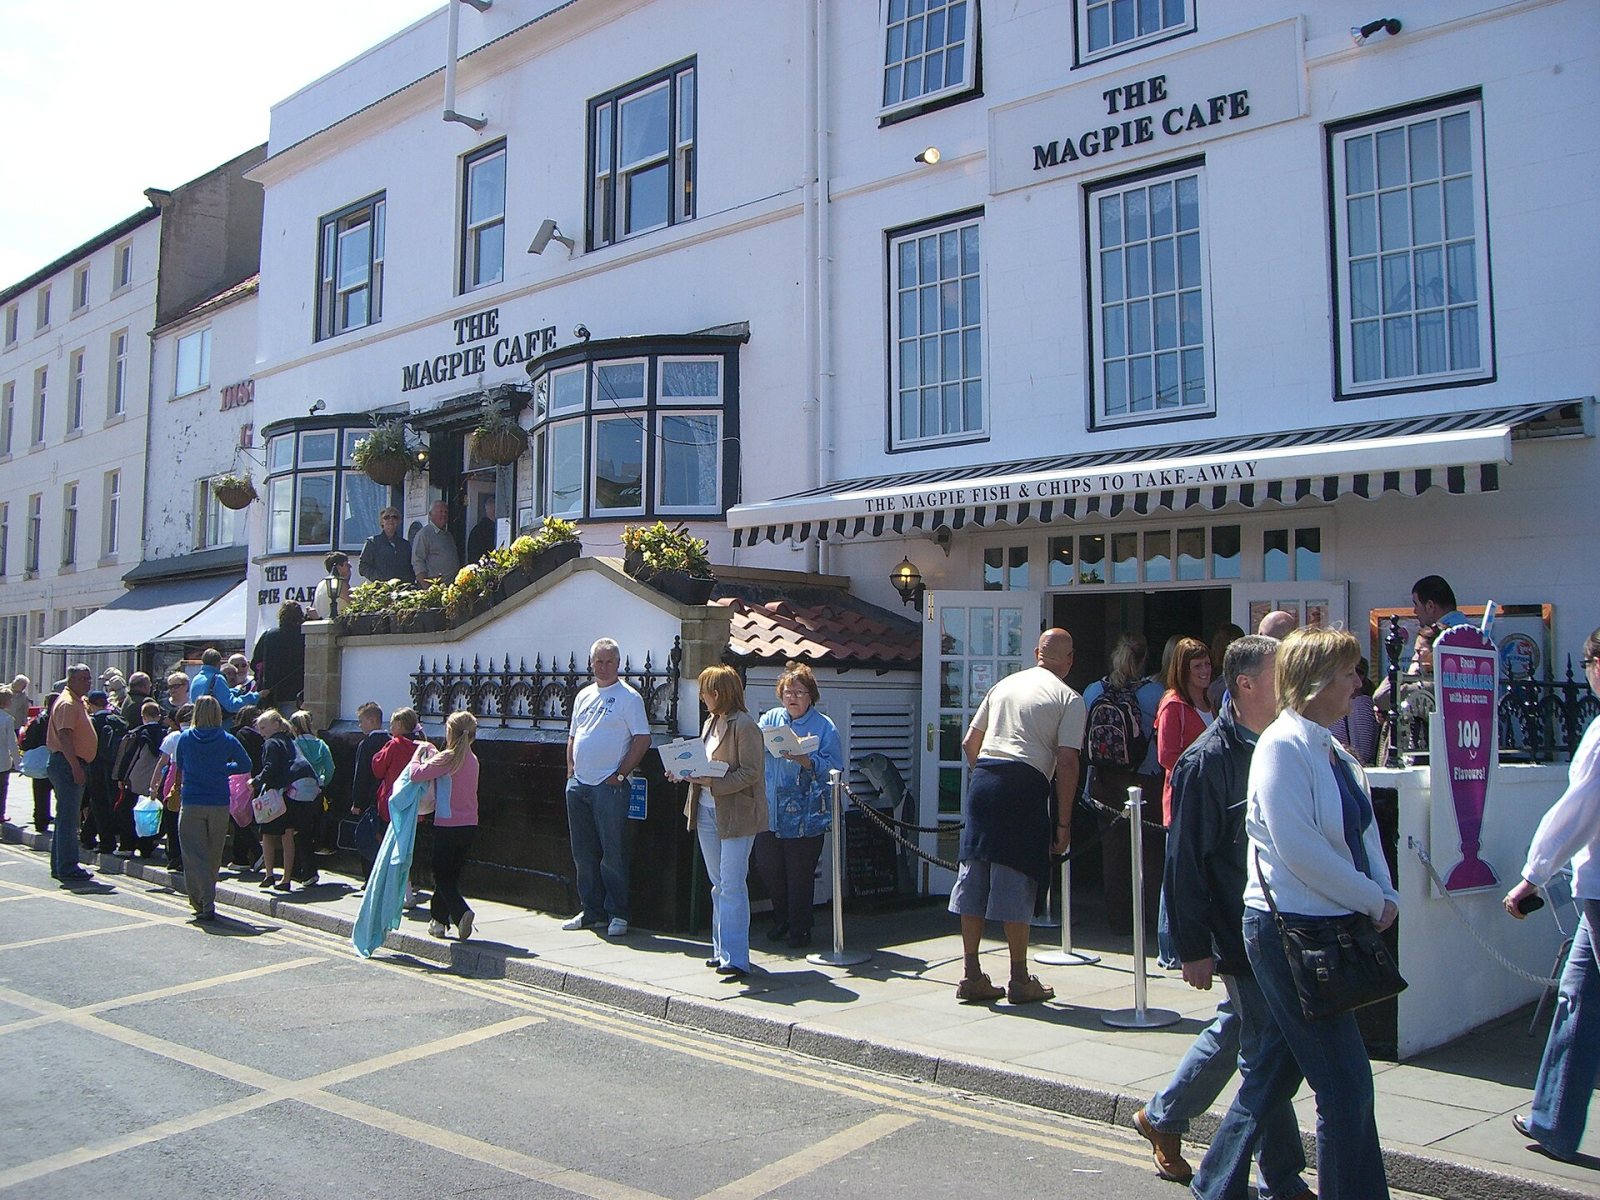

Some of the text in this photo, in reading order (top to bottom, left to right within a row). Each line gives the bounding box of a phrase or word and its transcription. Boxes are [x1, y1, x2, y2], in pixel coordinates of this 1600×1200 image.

[1103, 74, 1167, 114] THE
[1033, 90, 1250, 170] MAGPIE CAFE
[454, 308, 499, 346] THE
[401, 325, 557, 392] MAGPIE CAFE
[865, 461, 1259, 512] THE MAGPIE FISH & CHIPS TO TAKE-AWAY
[265, 565, 287, 582] THE
[285, 586, 316, 602] CAF
[1457, 720, 1481, 748] 100
